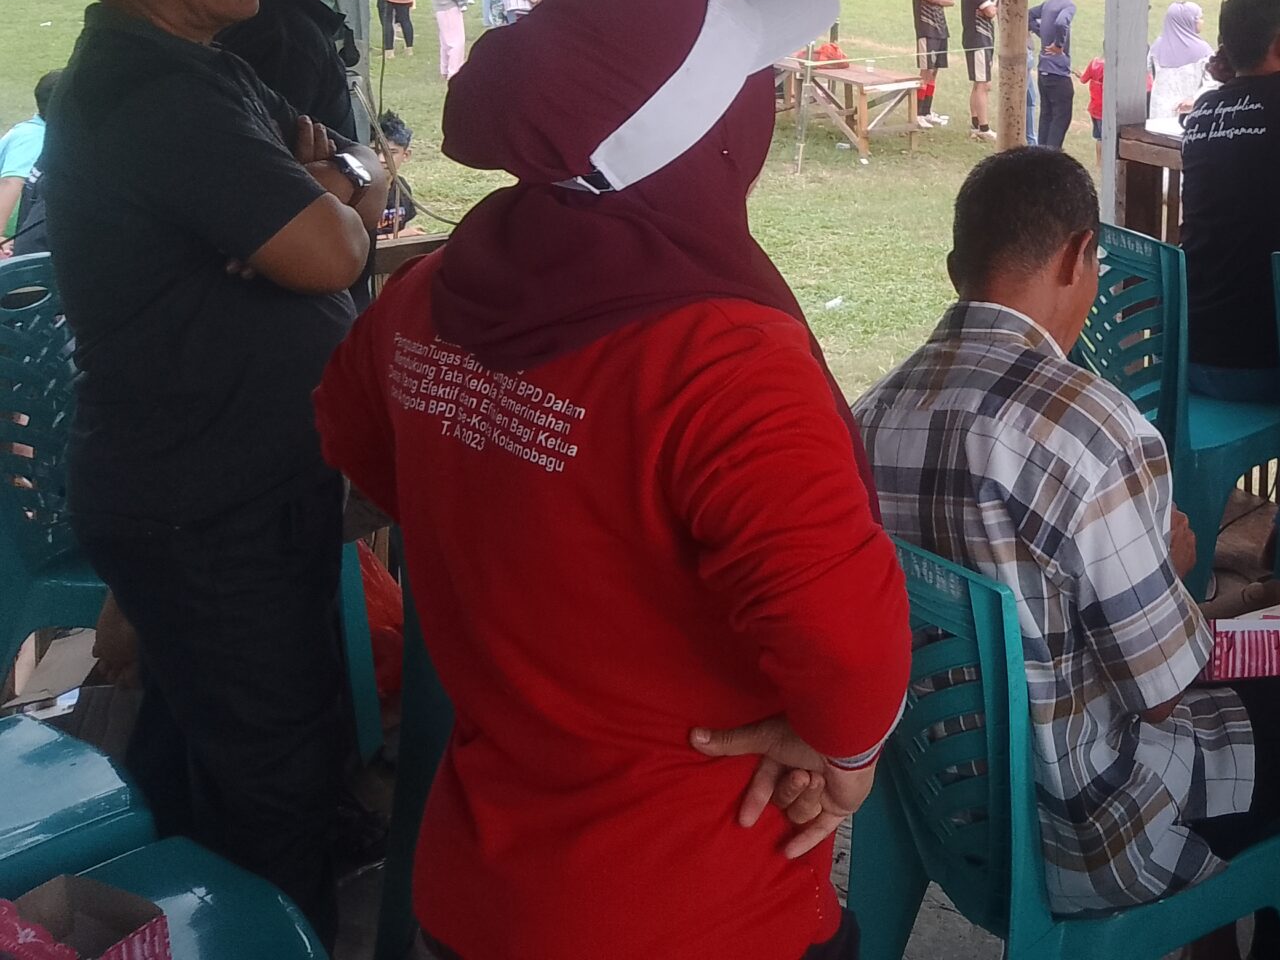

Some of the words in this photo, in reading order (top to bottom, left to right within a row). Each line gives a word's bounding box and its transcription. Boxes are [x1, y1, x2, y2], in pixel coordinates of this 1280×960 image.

[429, 344, 461, 365] Tugas
[517, 380, 543, 403] BPD
[543, 392, 586, 420] Dalam
[440, 365, 464, 383] Tata
[419, 378, 459, 401] Efektif
[509, 417, 536, 443] Bagi
[535, 430, 579, 458] Ketua
[427, 399, 456, 418] BPD
[491, 427, 565, 472] Kotamobagu
